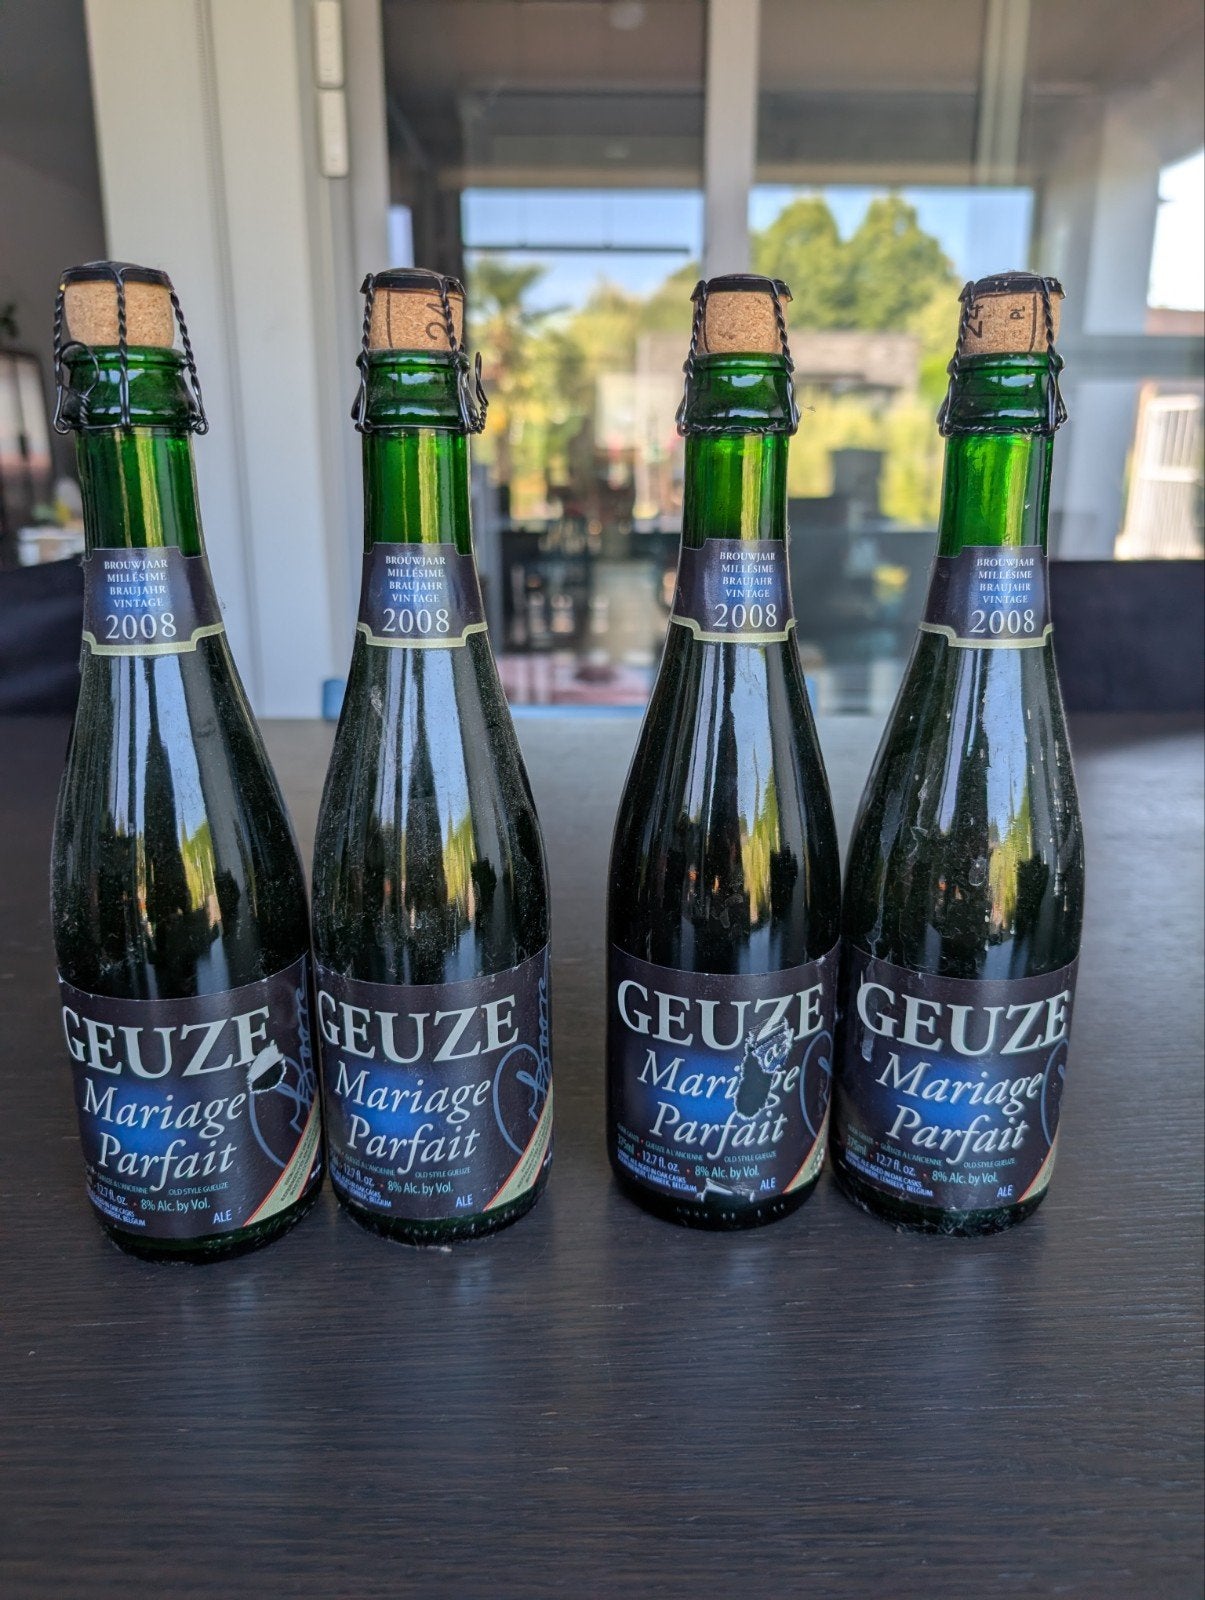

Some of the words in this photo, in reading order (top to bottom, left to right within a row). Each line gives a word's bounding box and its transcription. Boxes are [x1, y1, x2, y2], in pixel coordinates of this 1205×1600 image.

[104, 559, 169, 571] BROUWJAAR
[385, 555, 446, 567] BROUWJAAR
[719, 551, 776, 563] BROUWJAAR
[976, 557, 1035, 568] BROUWJAAR
[387, 566, 445, 578] MILLÉSIME
[721, 562, 775, 574] MILLÉSIME
[978, 568, 1033, 580] MILLÉSIME
[107, 571, 167, 583] MILLÉSIME
[722, 576, 773, 587] BRAUJAHR
[109, 585, 167, 597] BRAUJAHR
[389, 581, 443, 592] BRAUJAHR
[725, 588, 770, 598] VINTAGE
[979, 583, 1032, 594] BRAUJAHR
[113, 597, 165, 608] VINTAGE
[392, 593, 440, 603] VINTAGE
[982, 594, 1029, 605] VINTAGE
[382, 608, 450, 634] 2008
[712, 603, 778, 629] 2008
[969, 609, 1035, 634] 2008
[105, 612, 177, 640] 2008
[617, 979, 824, 1051] GEUZE
[856, 981, 1071, 1056] GEUZE
[317, 989, 519, 1064] GEUZE
[62, 1005, 270, 1079] GEUZE
[875, 1051, 1045, 1116] Mariage
[334, 1060, 492, 1125] Mariage
[83, 1078, 247, 1139] Mariage
[649, 1101, 789, 1159] Parfait
[885, 1104, 1031, 1164] Parfait
[346, 1113, 481, 1175] Parfait
[98, 1131, 238, 1192] Parfait
[694, 1164, 710, 1177] 8%
[711, 1166, 728, 1178] Alc.
[729, 1166, 741, 1180] by
[743, 1164, 760, 1177] Vol.
[931, 1170, 948, 1183] 8%
[948, 1172, 967, 1184] Alc.
[968, 1172, 980, 1187] by
[387, 1180, 402, 1193] 8%
[403, 1182, 420, 1194] Alc.
[422, 1182, 434, 1197] by
[435, 1180, 454, 1193] Vol.
[759, 1176, 776, 1192] ALE
[996, 1184, 1014, 1198] ALE
[141, 1198, 156, 1211] 8%
[157, 1200, 174, 1212] Alc.
[176, 1200, 189, 1214] by
[190, 1197, 211, 1210] Vol.
[455, 1193, 474, 1208] ALE
[212, 1209, 233, 1224] ALE
